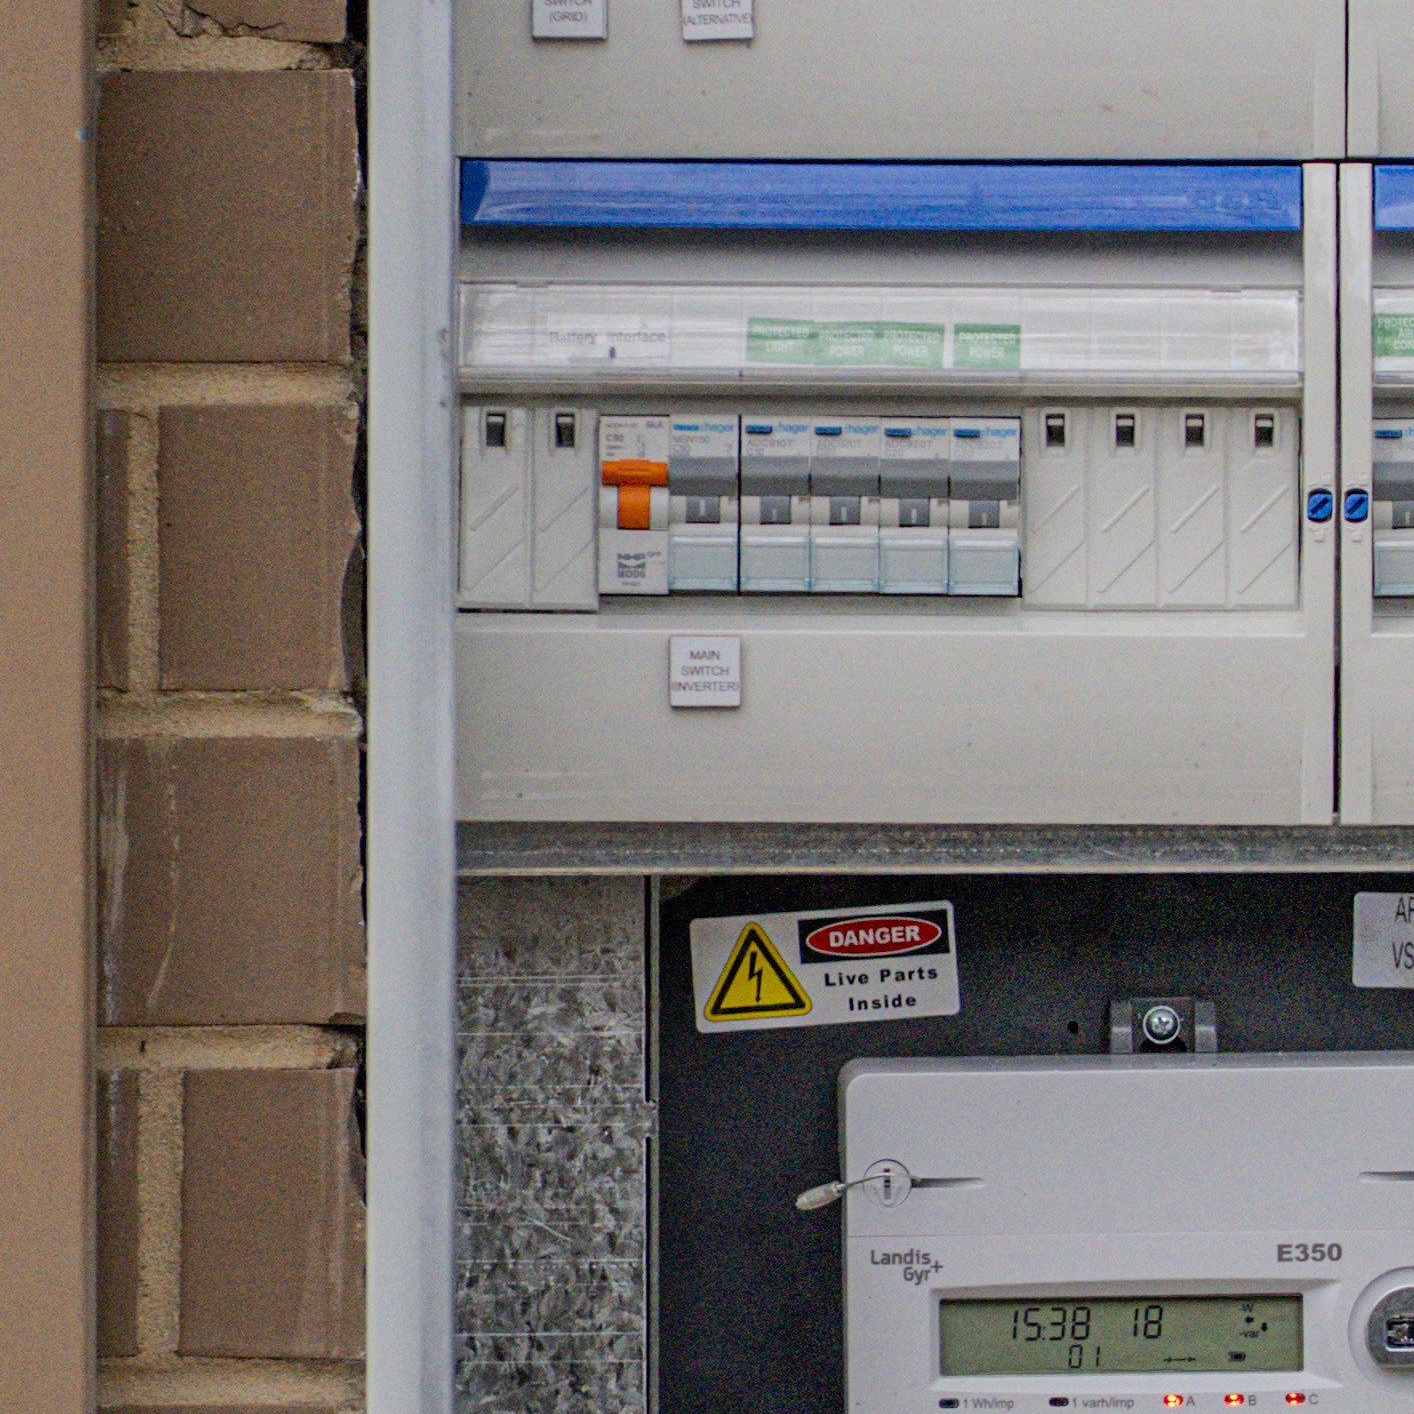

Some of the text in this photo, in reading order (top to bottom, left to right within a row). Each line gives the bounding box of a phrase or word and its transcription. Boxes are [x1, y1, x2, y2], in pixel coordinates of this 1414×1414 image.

[550, 12, 587, 23] (GRID)
[607, 331, 666, 343] Interface
[690, 650, 720, 660] MAIN
[681, 666, 730, 676] SWITCH
[672, 681, 739, 692] (INVERTER)
[829, 925, 920, 948] DANGER
[825, 967, 938, 987] Live Parts
[849, 994, 917, 1011] Inside
[870, 1248, 932, 1266] Landis
[1276, 1244, 1342, 1263] E350
[971, 1398, 1014, 1411] Wh/imp
[1083, 1396, 1134, 1410] varh/imp
